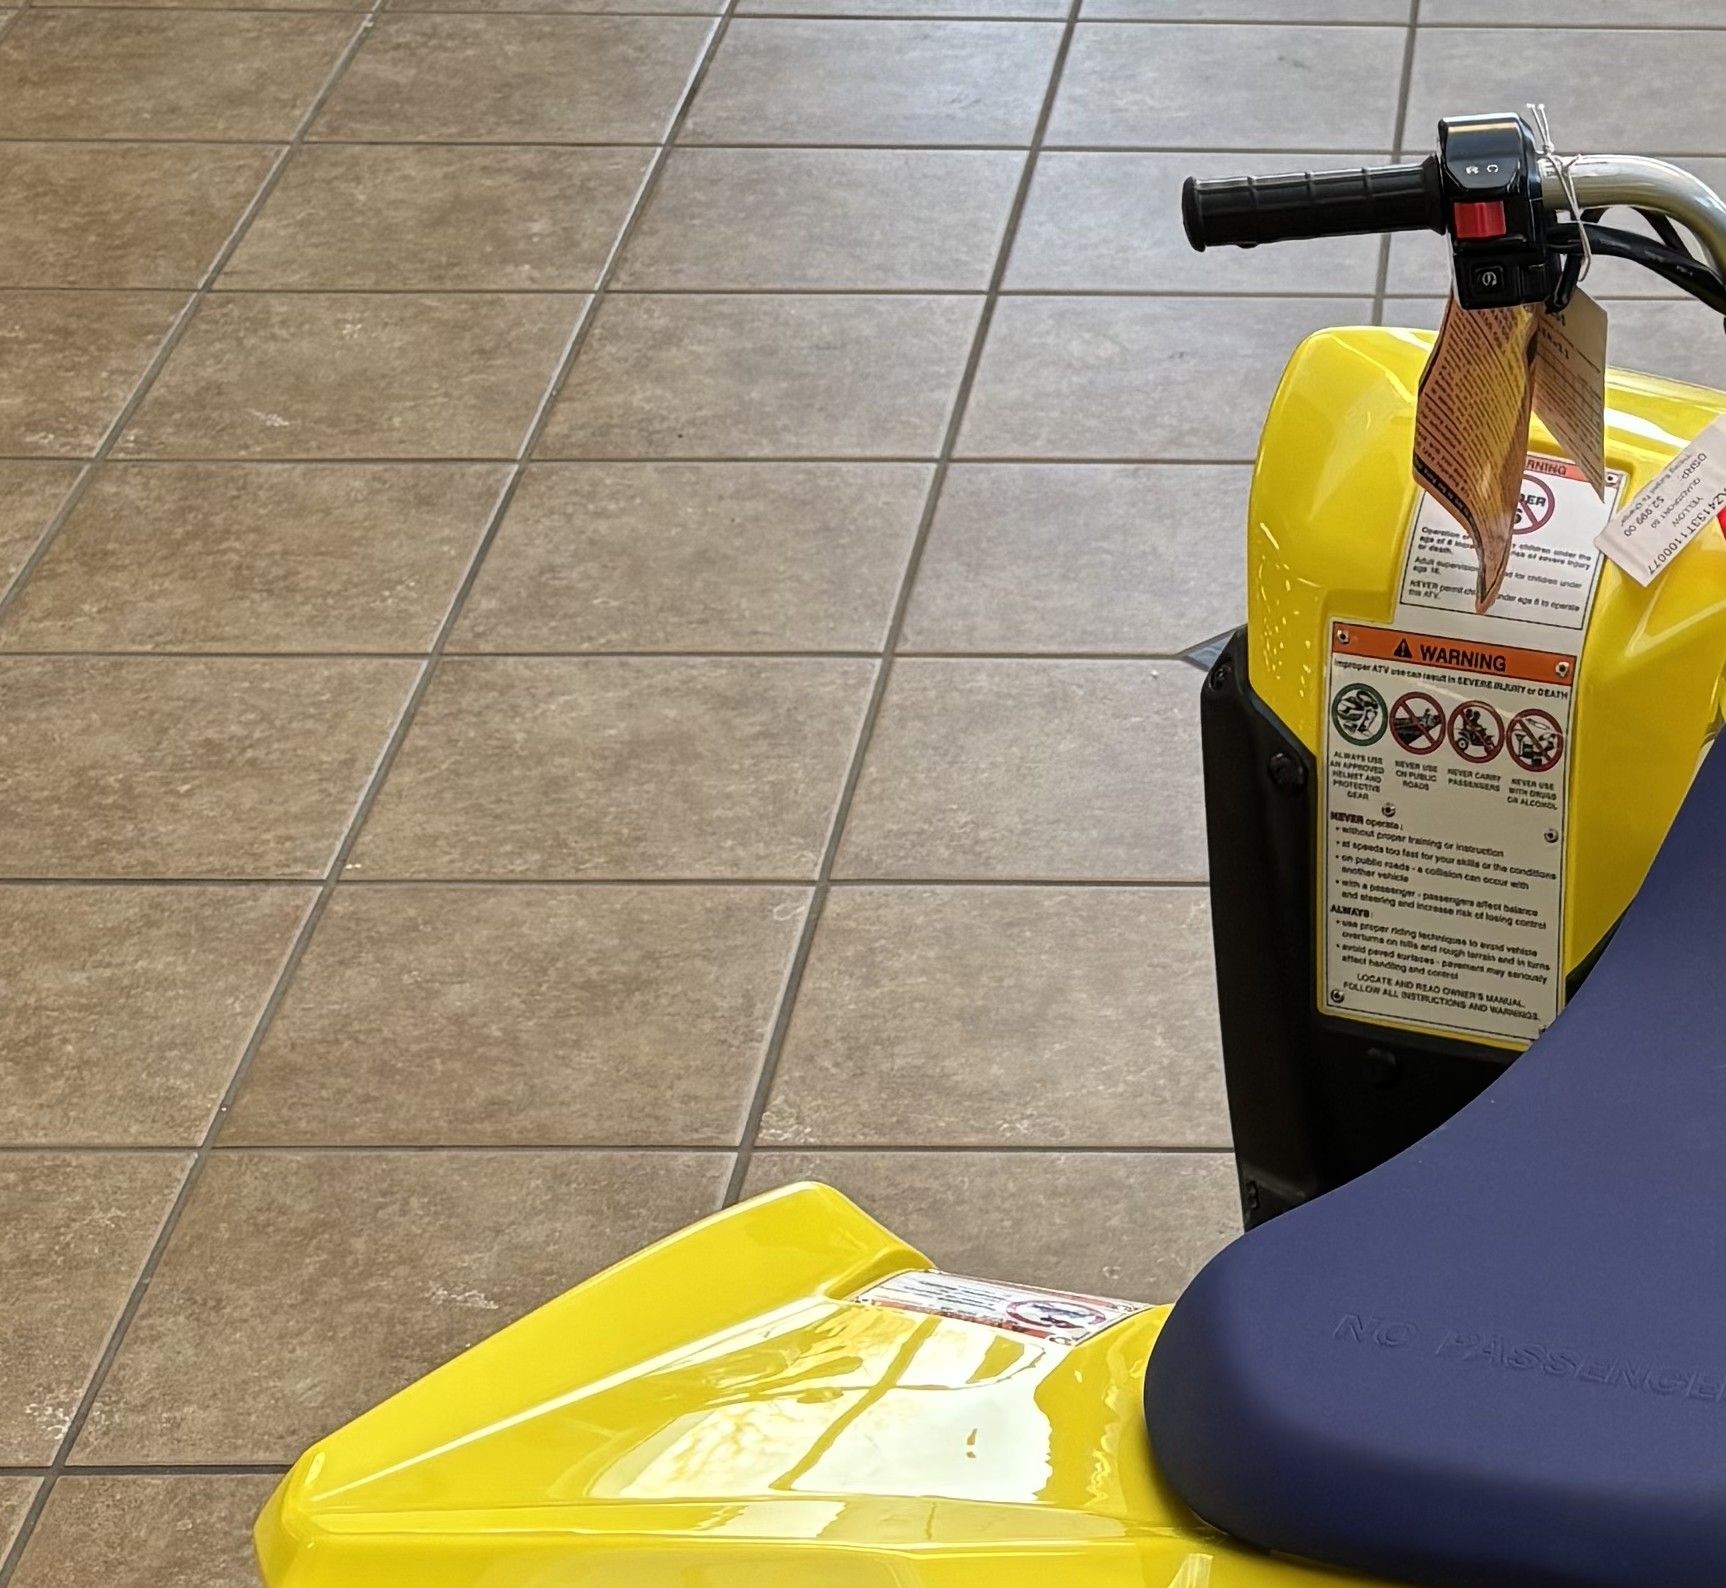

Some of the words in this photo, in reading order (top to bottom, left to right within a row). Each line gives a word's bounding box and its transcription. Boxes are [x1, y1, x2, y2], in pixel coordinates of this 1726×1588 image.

[1526, 458, 1567, 475] RNING
[1670, 494, 1703, 527] YELLOW
[1435, 560, 1479, 573] supervisio
[1419, 644, 1506, 672] WARNING
[1333, 750, 1365, 762] ALWAYS
[1366, 755, 1383, 764] USE
[1394, 759, 1420, 770] NEVER
[1422, 763, 1437, 772] USE
[1332, 769, 1362, 780] HELMET
[1365, 774, 1381, 783] AND
[1343, 761, 1384, 774] APPROVED
[1395, 769, 1406, 777] ON
[1408, 771, 1436, 782] PUBLIC
[1447, 767, 1472, 778] NEVER
[1474, 772, 1501, 782] CARRY
[1333, 779, 1380, 792] PROTECTIVE
[1402, 779, 1429, 790] ROADS
[1447, 777, 1500, 791] PASSENGERS
[1511, 777, 1536, 788] NEVER
[1538, 781, 1554, 791] USE
[1346, 790, 1368, 800] GEAR
[1506, 795, 1518, 804] OR
[1508, 786, 1528, 796] WITH
[1529, 789, 1556, 800] DRUGS
[1330, 811, 1363, 824] NEVER
[1342, 826, 1374, 837] without
[1376, 832, 1406, 843] proper
[1408, 835, 1442, 849] training
[1455, 842, 1504, 857] instruction
[1341, 840, 1350, 848] at
[1353, 842, 1383, 854] speeds
[1385, 846, 1400, 855] too
[1403, 848, 1418, 858] fast
[1421, 851, 1433, 860] for
[1435, 855, 1454, 865] your
[1456, 857, 1479, 868] skills
[1492, 863, 1507, 872] the
[1509, 865, 1556, 880] conditions
[1341, 854, 1353, 862] on
[1355, 856, 1382, 867] public
[1384, 860, 1409, 871] roads
[1425, 866, 1462, 879] collision
[1464, 873, 1481, 882] can
[1482, 876, 1507, 887] occur
[1510, 880, 1529, 890] with
[1342, 865, 1374, 877] another
[1377, 870, 1408, 882] vehicle
[1342, 879, 1360, 888] with
[1370, 884, 1415, 898] passenger
[1422, 892, 1474, 908] passengers
[1476, 899, 1501, 911] affect
[1503, 904, 1538, 916] balance
[1341, 890, 1358, 899] and
[1360, 893, 1395, 907] steering
[1397, 899, 1414, 908] and
[1416, 902, 1453, 914] increase
[1455, 908, 1472, 917] risk
[1474, 911, 1484, 920] of
[1485, 912, 1512, 926] losing
[1515, 917, 1546, 930] control
[1342, 920, 1358, 928] use
[1360, 922, 1388, 934] proper
[1390, 926, 1416, 939] riding
[1418, 931, 1467, 946] techniques
[1468, 939, 1478, 947] to
[1479, 941, 1504, 952] avoid
[1506, 945, 1537, 956] vehicle
[1341, 931, 1384, 943] overturns
[1385, 938, 1397, 946] on
[1399, 939, 1418, 949] hills
[1420, 943, 1437, 952] and
[1439, 945, 1465, 958] rough
[1467, 950, 1496, 961] terrain
[1497, 955, 1514, 964] and
[1516, 958, 1525, 966] in
[1527, 960, 1550, 970] turns
[1342, 943, 1365, 953] avoid
[1367, 947, 1394, 959] paved
[1396, 951, 1434, 964] surfaces
[1441, 959, 1484, 973] pavement
[1485, 966, 1505, 978] may
[1507, 969, 1547, 984] seriously
[1342, 954, 1366, 965] affect
[1368, 958, 1406, 973] handling
[1408, 965, 1425, 975] and
[1427, 968, 1458, 980] control
[1356, 972, 1393, 985] LOCATE
[1394, 978, 1414, 989] AND
[1415, 982, 1440, 993] READ
[1343, 981, 1380, 994] FOLLOW
[1381, 987, 1398, 998] ALL
[1400, 991, 1466, 1009] INSTRUCTIONS
[1468, 1001, 1487, 1012] AND
[1332, 1311, 1420, 1349] NO
